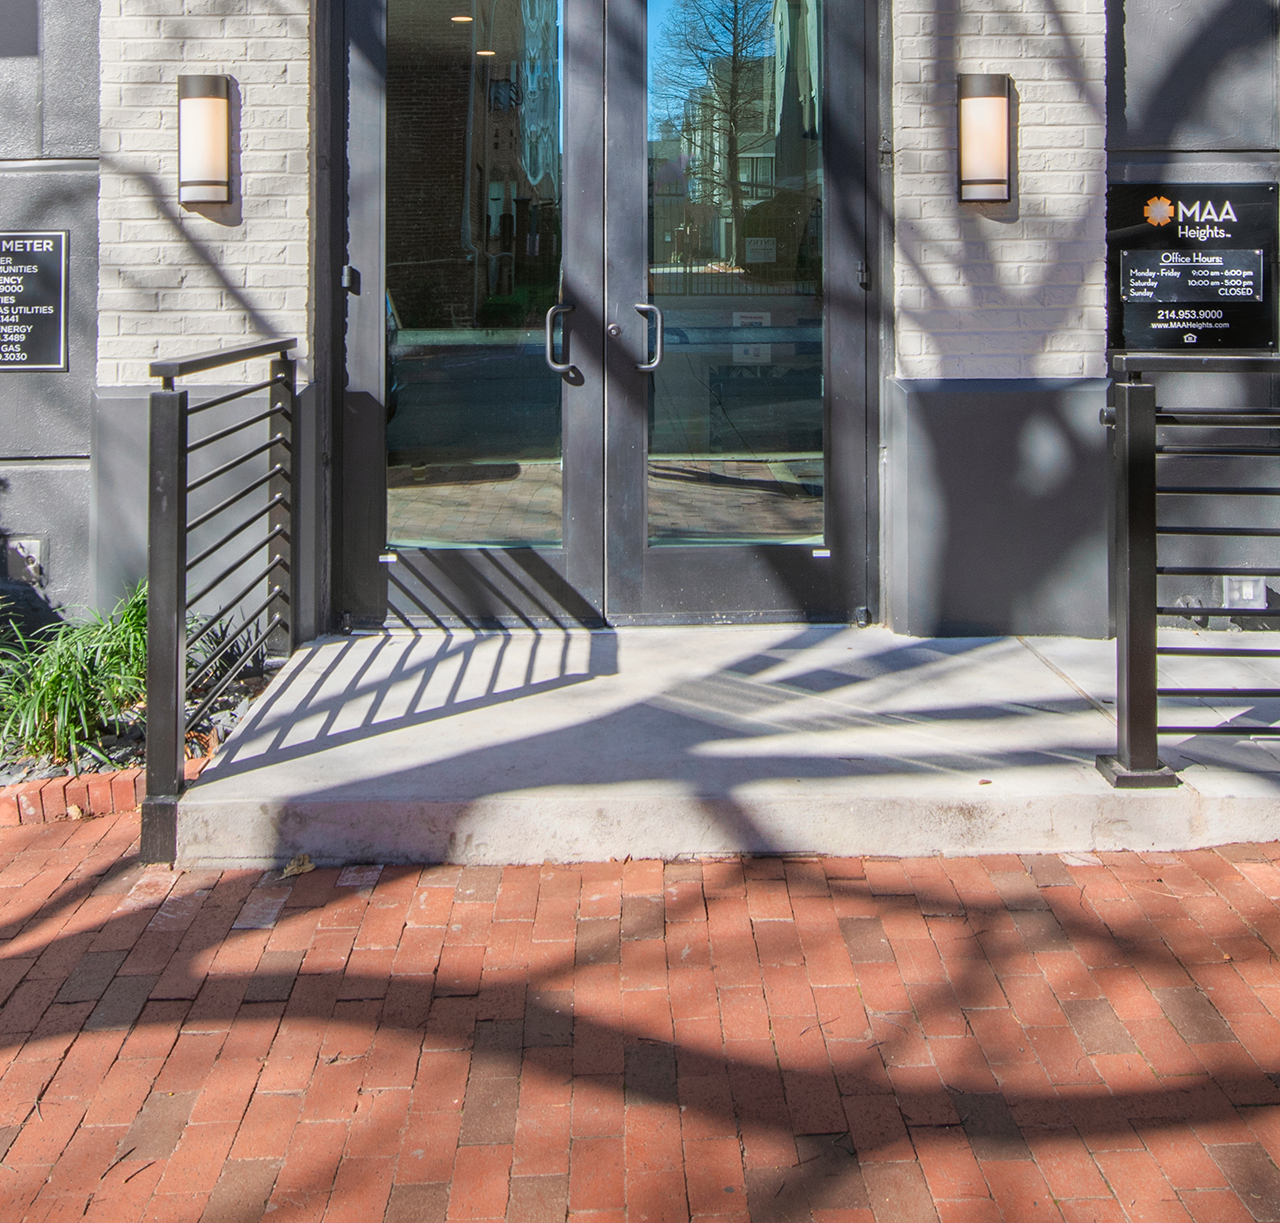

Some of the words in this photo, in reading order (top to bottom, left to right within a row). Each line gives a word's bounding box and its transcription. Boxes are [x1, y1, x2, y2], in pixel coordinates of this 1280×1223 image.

[1178, 200, 1238, 222] MAA
[1, 240, 54, 252] METER
[1161, 252, 1191, 263] Office
[1192, 252, 1223, 263] Hours:
[1130, 268, 1156, 278] Monday
[1160, 268, 1181, 278] Friday
[1130, 278, 1158, 288] Saturday
[1130, 288, 1154, 298] Sunday
[1218, 287, 1253, 296] CLOSED
[11, 306, 54, 314] UTILITIES
[1157, 310, 1223, 320] 214.953.9000
[1151, 321, 1230, 330] www.MAAHeights.com
[0, 344, 21, 352] GAS
